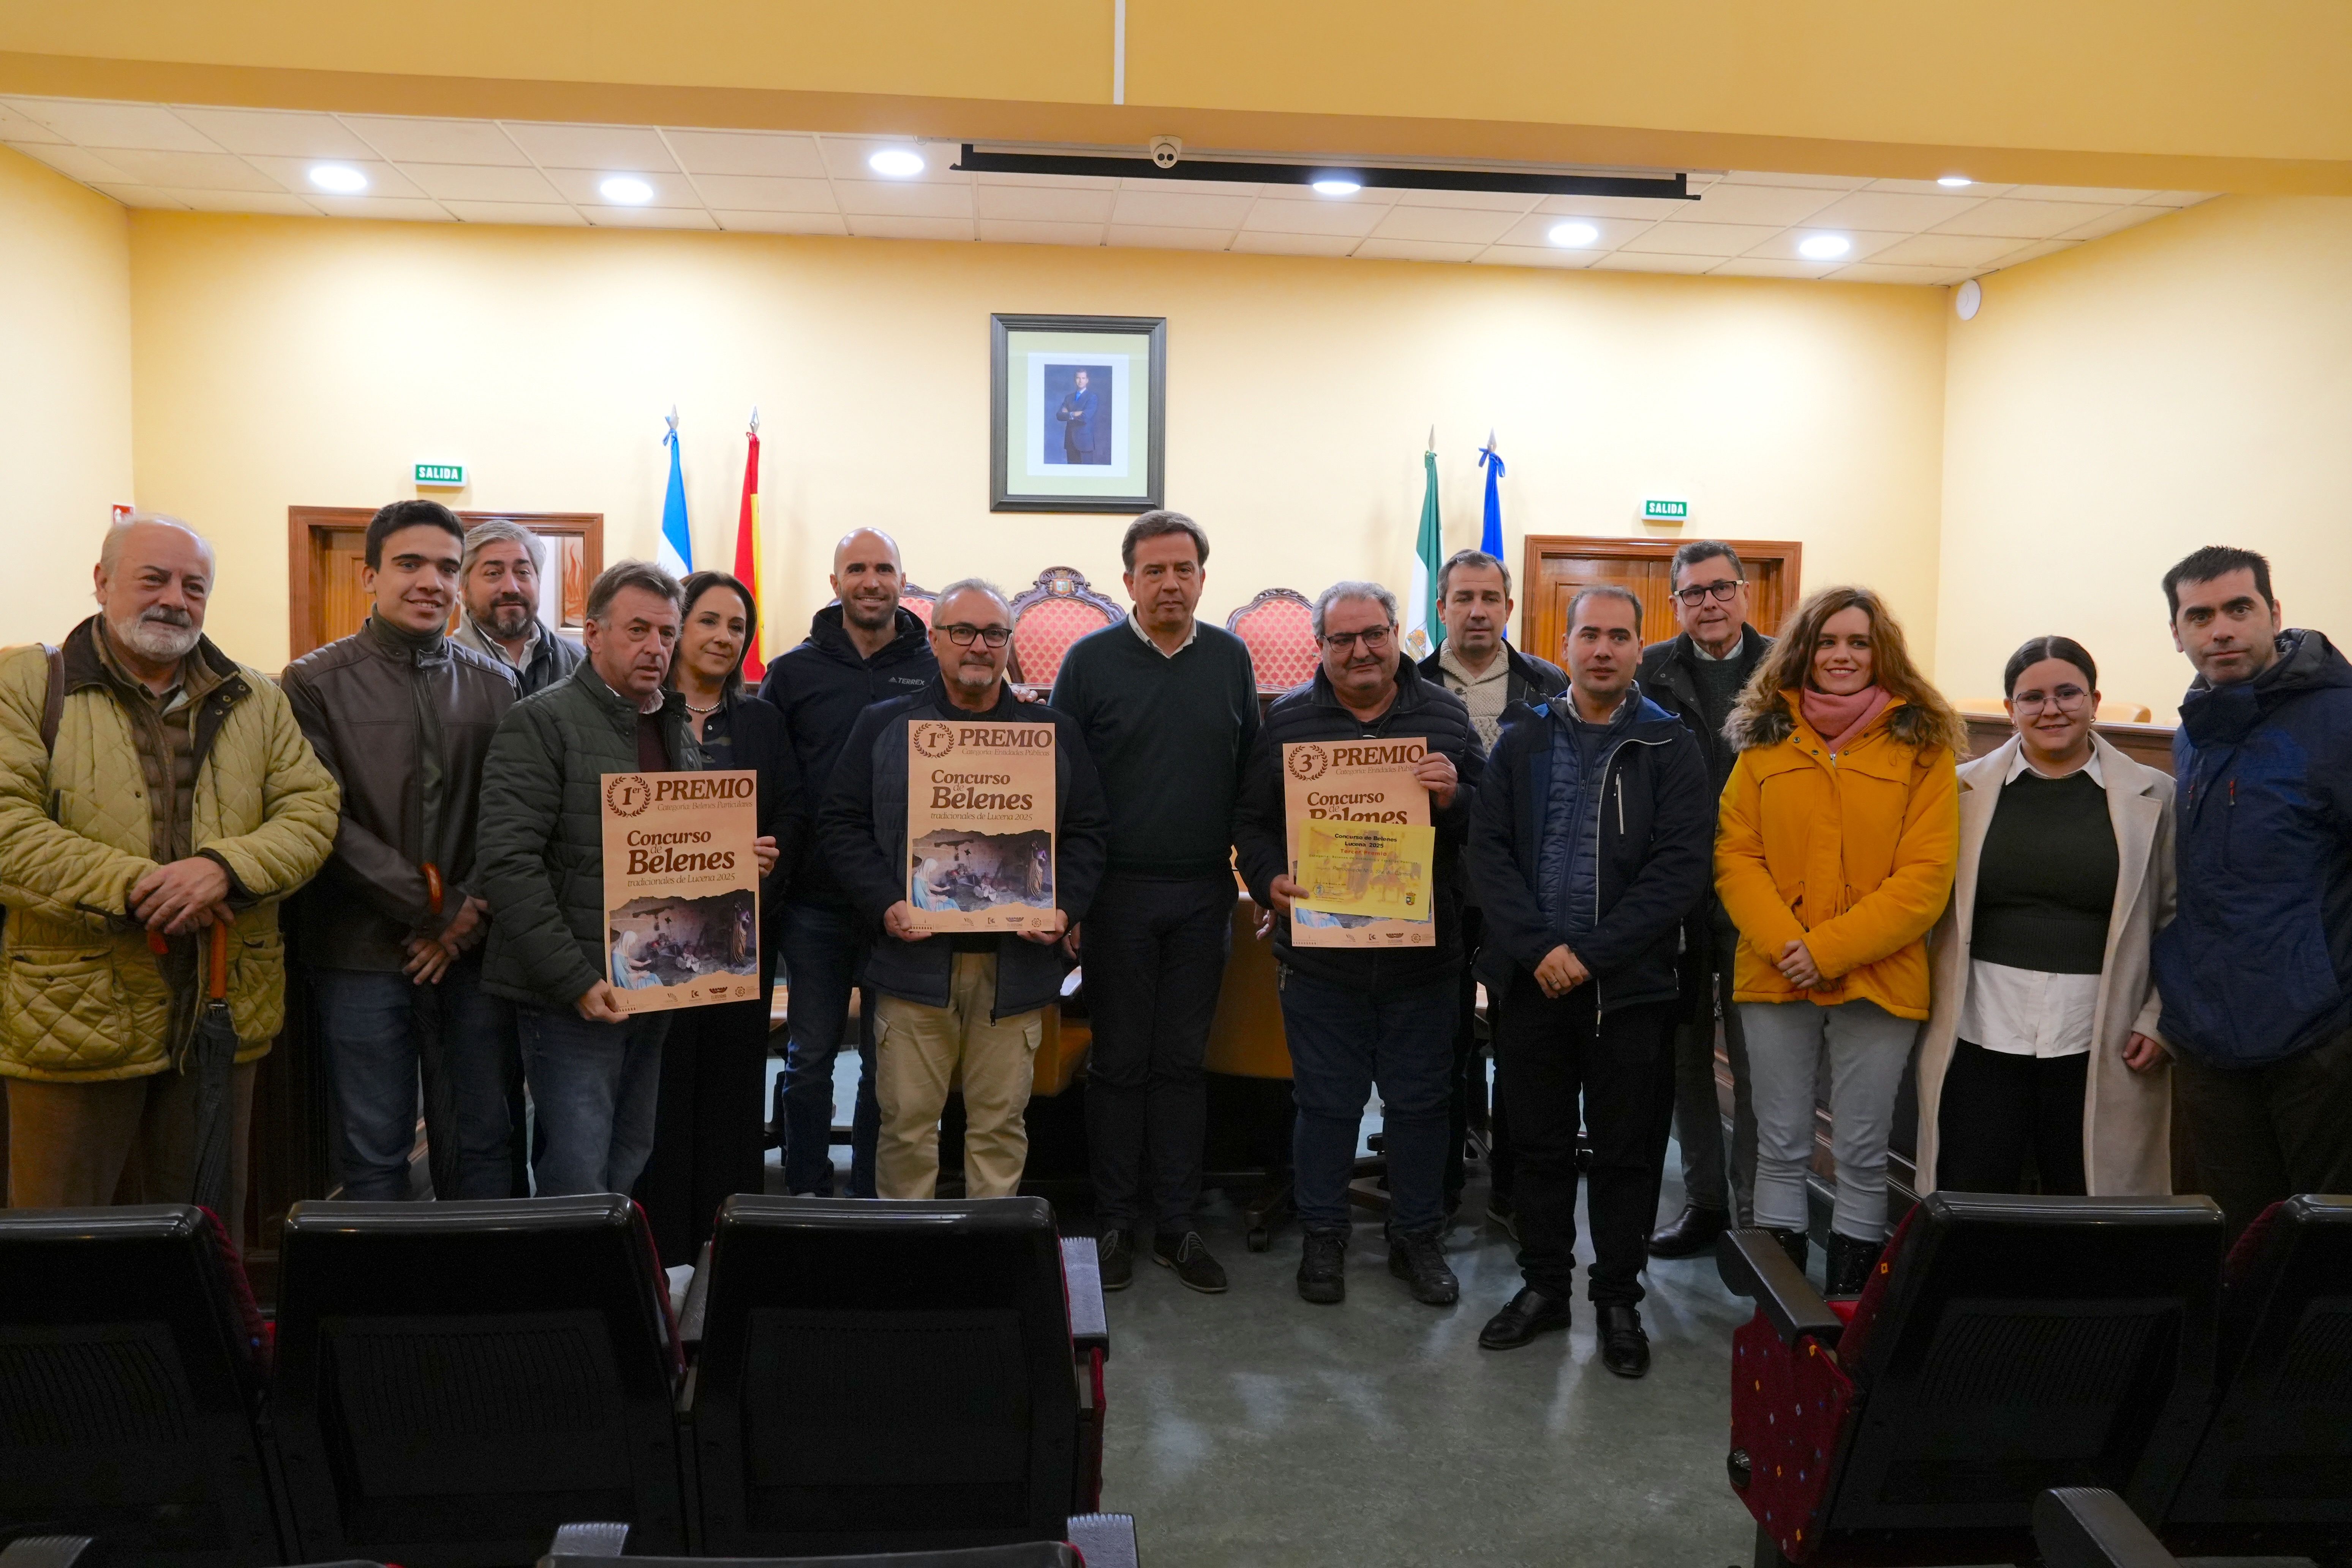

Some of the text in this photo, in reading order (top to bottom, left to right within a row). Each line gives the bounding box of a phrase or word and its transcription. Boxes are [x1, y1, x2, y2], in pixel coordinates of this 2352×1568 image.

[419, 467, 458, 479] SALIDA
[1649, 503, 1683, 514] SALIDA
[898, 677, 925, 686] TERREX
[928, 729, 1052, 748] 1er PREMIO
[1299, 744, 1424, 773] 3er PREMIO
[931, 770, 1010, 784] Concurso
[622, 778, 754, 805] 1er PREMIO
[953, 782, 964, 791] de
[930, 786, 1032, 810] Belenes
[1307, 792, 1385, 806] Concurso
[1329, 804, 1339, 812] de
[628, 830, 711, 846] Concurso
[651, 844, 662, 854] de
[626, 847, 735, 874] Belenes
[628, 877, 674, 887] tradicionales
